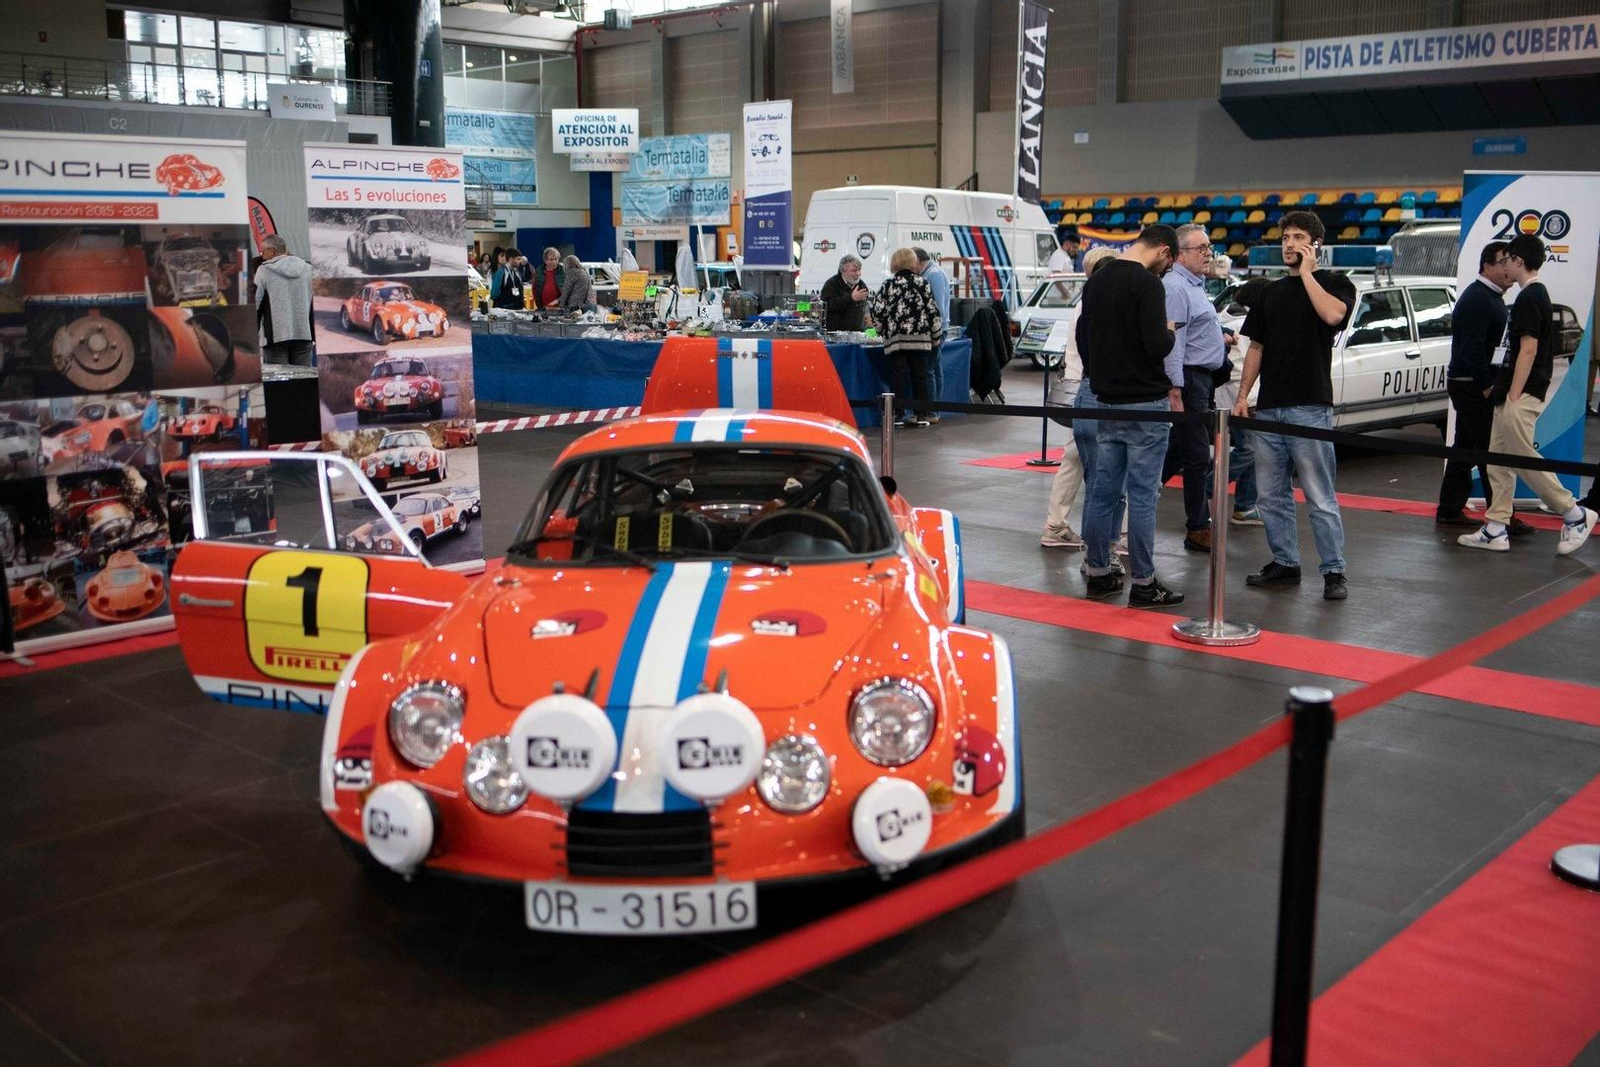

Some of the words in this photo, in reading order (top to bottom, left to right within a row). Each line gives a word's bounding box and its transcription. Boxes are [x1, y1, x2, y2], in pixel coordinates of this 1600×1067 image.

[1305, 43, 1354, 70] PISTA
[1360, 41, 1384, 67] DE
[1388, 32, 1496, 64] ATLETISMO
[1502, 23, 1599, 56] CUBERTA
[1226, 65, 1296, 77] Expourense
[294, 102, 325, 110] OURENSE
[1019, 22, 1048, 189] LANCIA
[109, 117, 127, 130] C2
[444, 113, 495, 129] ermatalia
[574, 115, 605, 123] OFICINA
[619, 124, 634, 134] AL
[564, 136, 629, 147] EXPOSITOR
[645, 146, 706, 167] Termatalia
[311, 159, 424, 173] ALPINCHE
[326, 187, 349, 201] Las
[355, 188, 362, 201] 5
[366, 189, 447, 204] evoluciones
[667, 183, 729, 203] Termatalia
[1, 204, 85, 218] Restauración
[85, 205, 115, 217] 2015
[1491, 208, 1571, 241] 200
[911, 231, 943, 242] MARTINI
[1382, 365, 1447, 396] POLICIA
[286, 566, 323, 637] 1
[264, 645, 352, 673] PIRELL
[532, 888, 579, 927] OR
[621, 888, 750, 929] 31516
